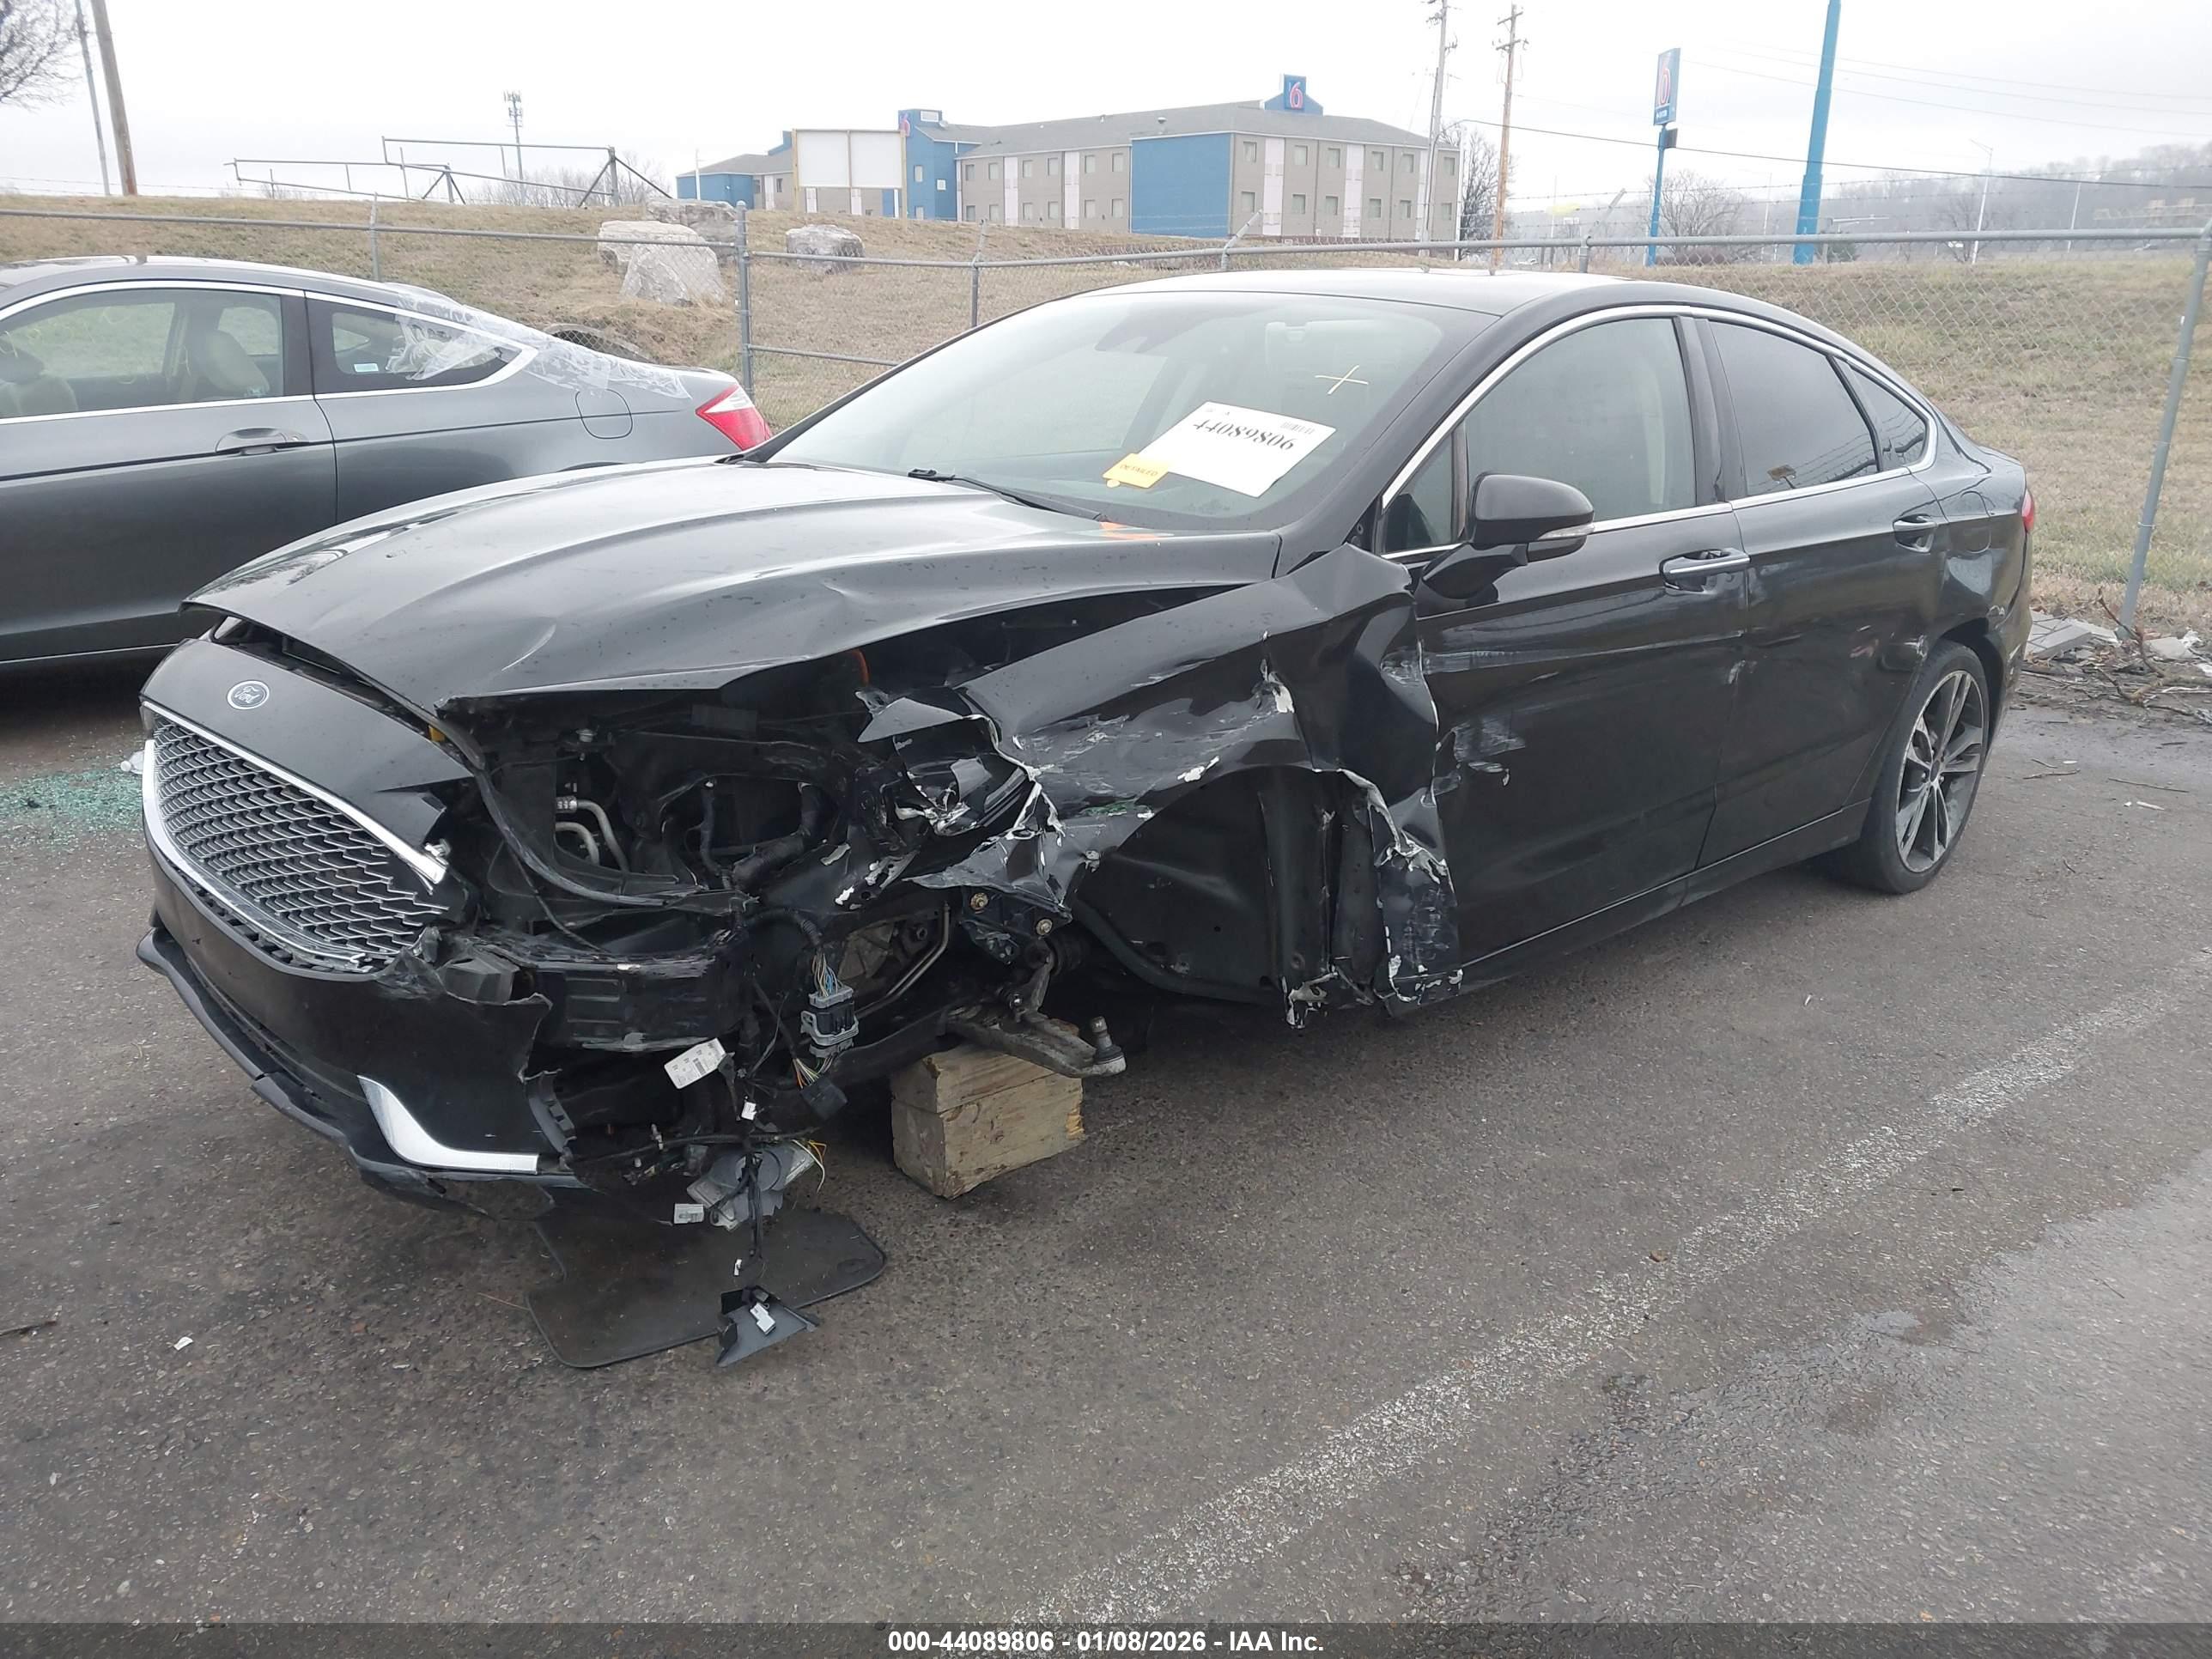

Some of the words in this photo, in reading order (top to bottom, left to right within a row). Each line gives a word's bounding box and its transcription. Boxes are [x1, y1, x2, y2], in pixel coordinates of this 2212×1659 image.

[1289, 82, 1304, 109] 6
[1193, 418, 1297, 451] 44089806
[234, 685, 261, 704] Ford
